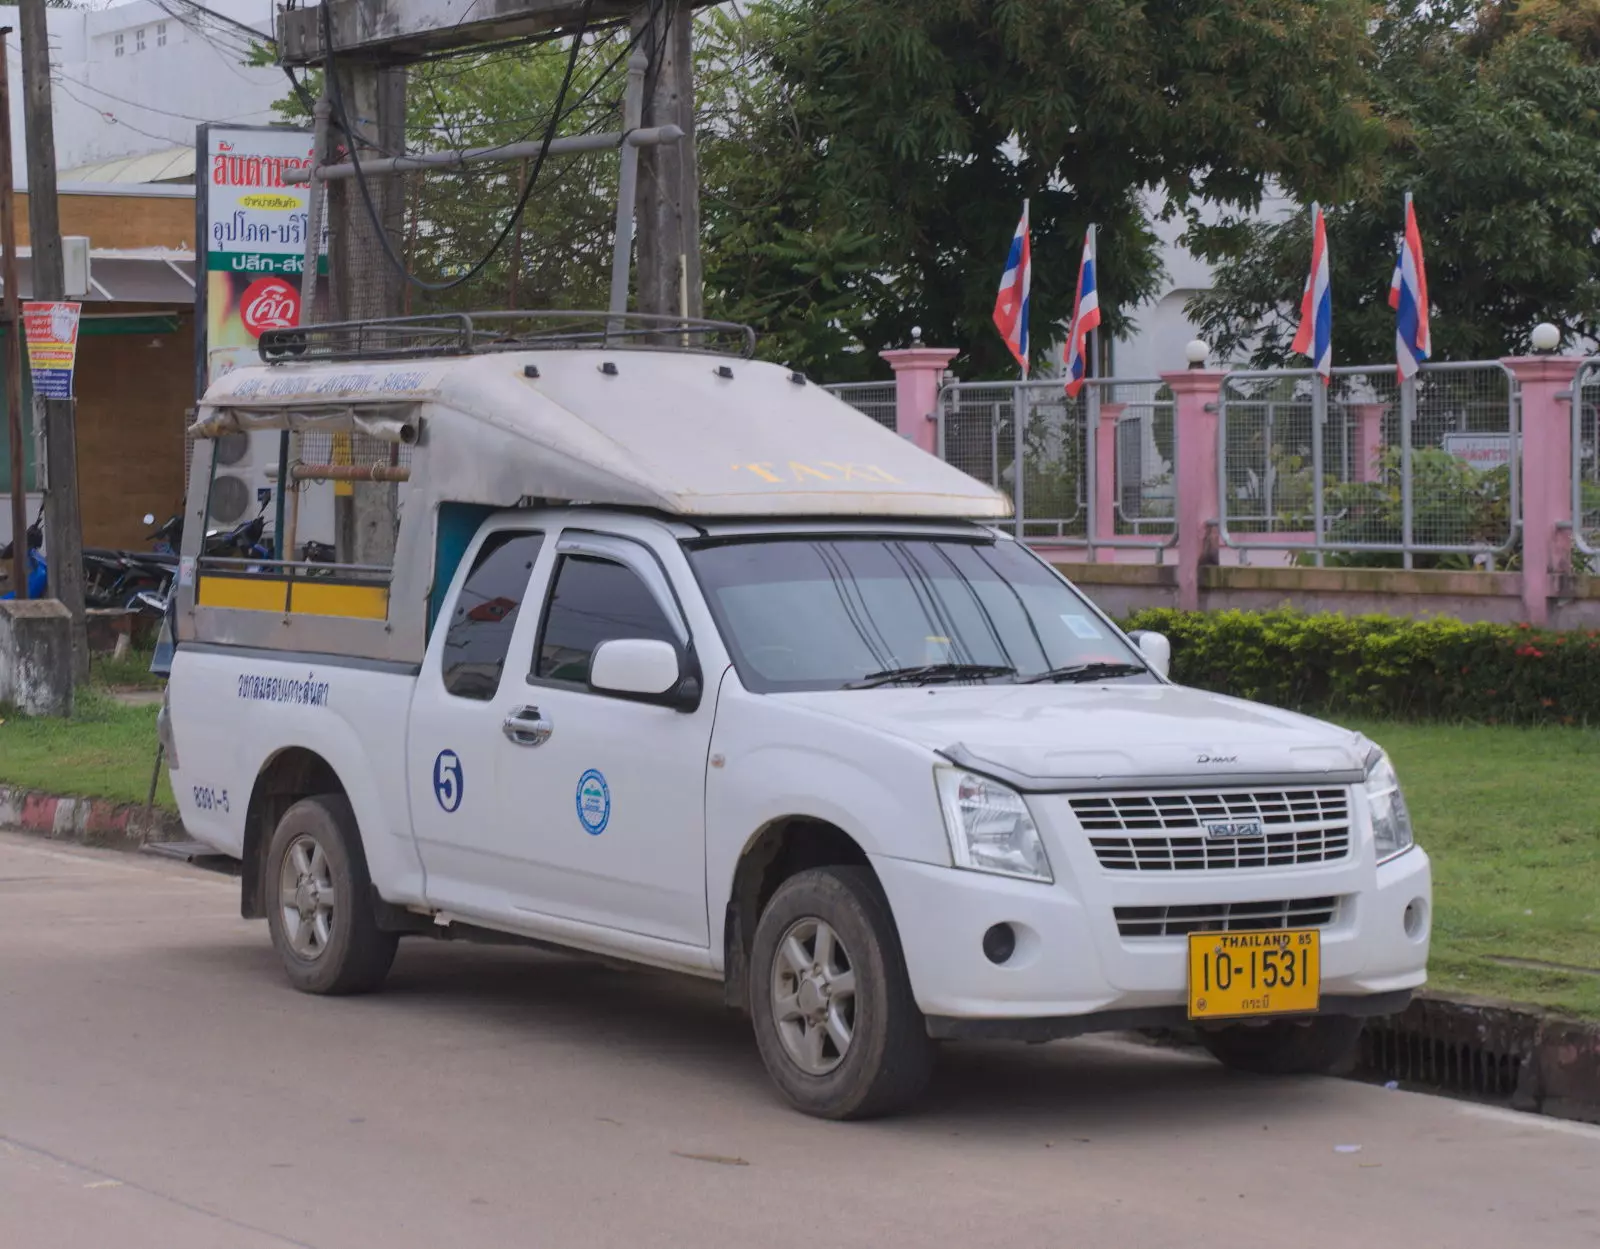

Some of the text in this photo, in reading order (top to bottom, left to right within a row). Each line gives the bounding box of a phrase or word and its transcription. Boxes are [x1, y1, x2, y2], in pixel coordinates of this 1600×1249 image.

[213, 210, 328, 251] อุปโภค-บริโ
[439, 754, 458, 811] 5
[1209, 823, 1261, 837] ISUZU
[1221, 933, 1312, 949] THAILAND 85
[1203, 949, 1308, 992] 10-1531
